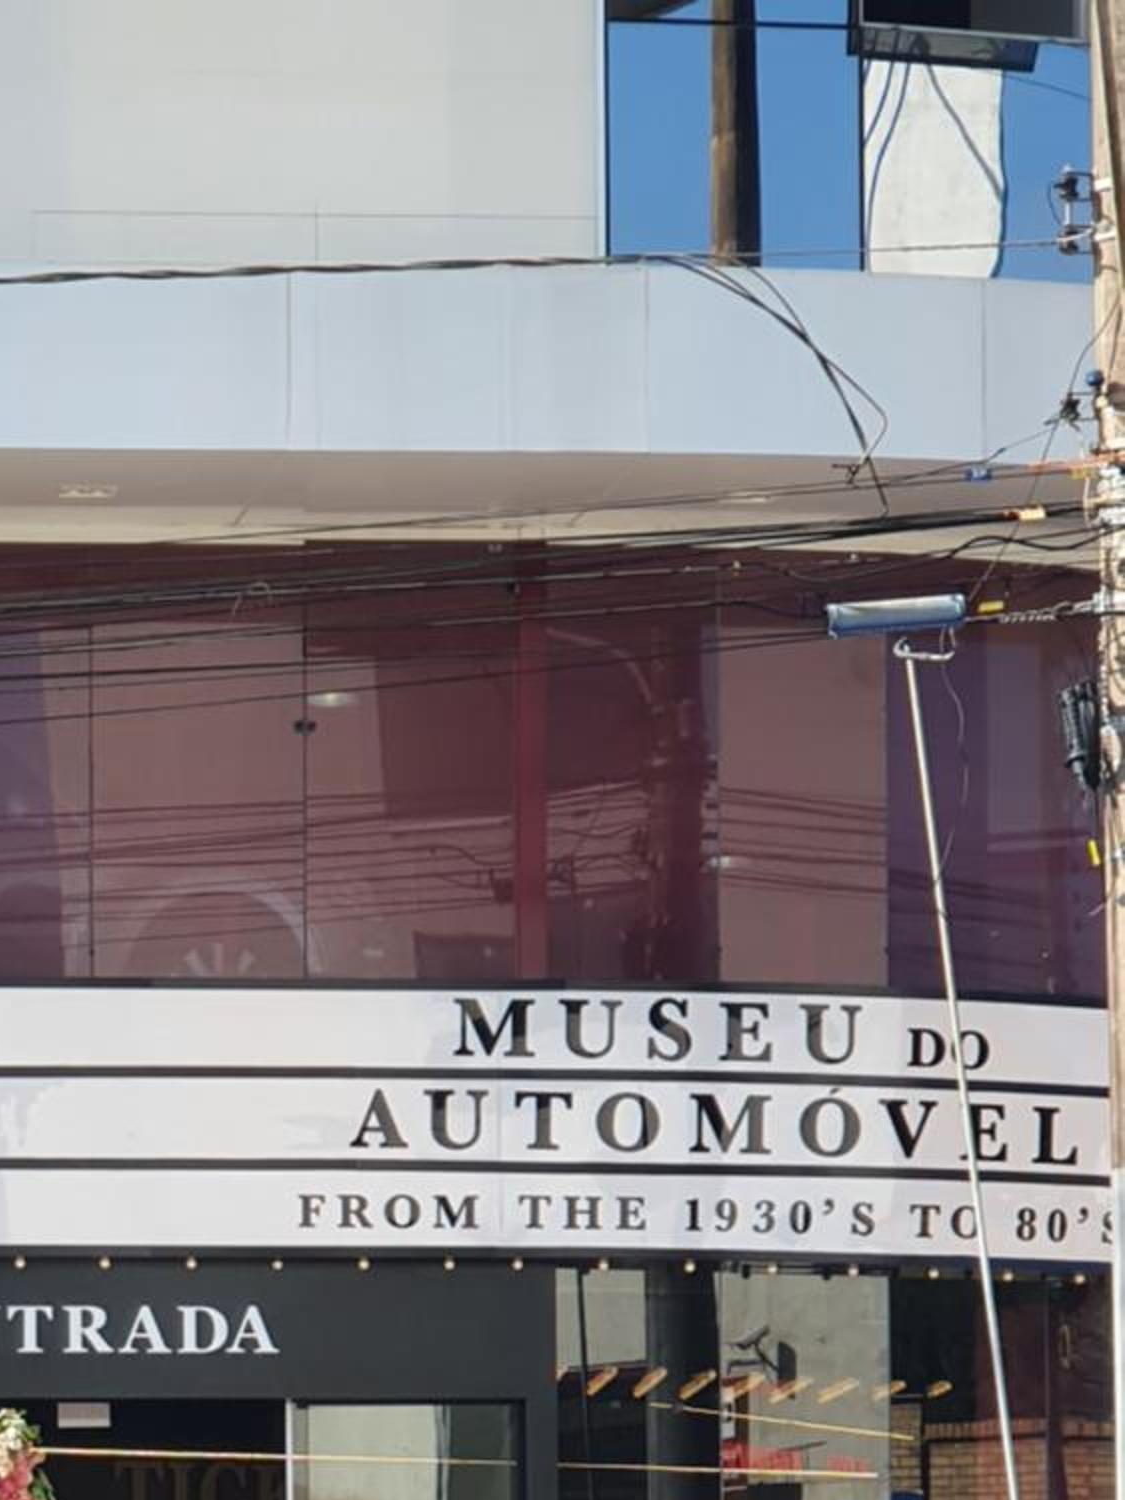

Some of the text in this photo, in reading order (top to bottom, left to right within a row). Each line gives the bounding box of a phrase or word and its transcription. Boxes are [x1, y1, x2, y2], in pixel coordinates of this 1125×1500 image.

[453, 997, 990, 1071] MUSEU DO
[350, 1087, 1079, 1166] AUTOMÓVEL
[297, 1193, 480, 1231] FROM
[518, 1194, 648, 1232] THE
[683, 1197, 876, 1238] 1930'S
[909, 1203, 979, 1240] TO
